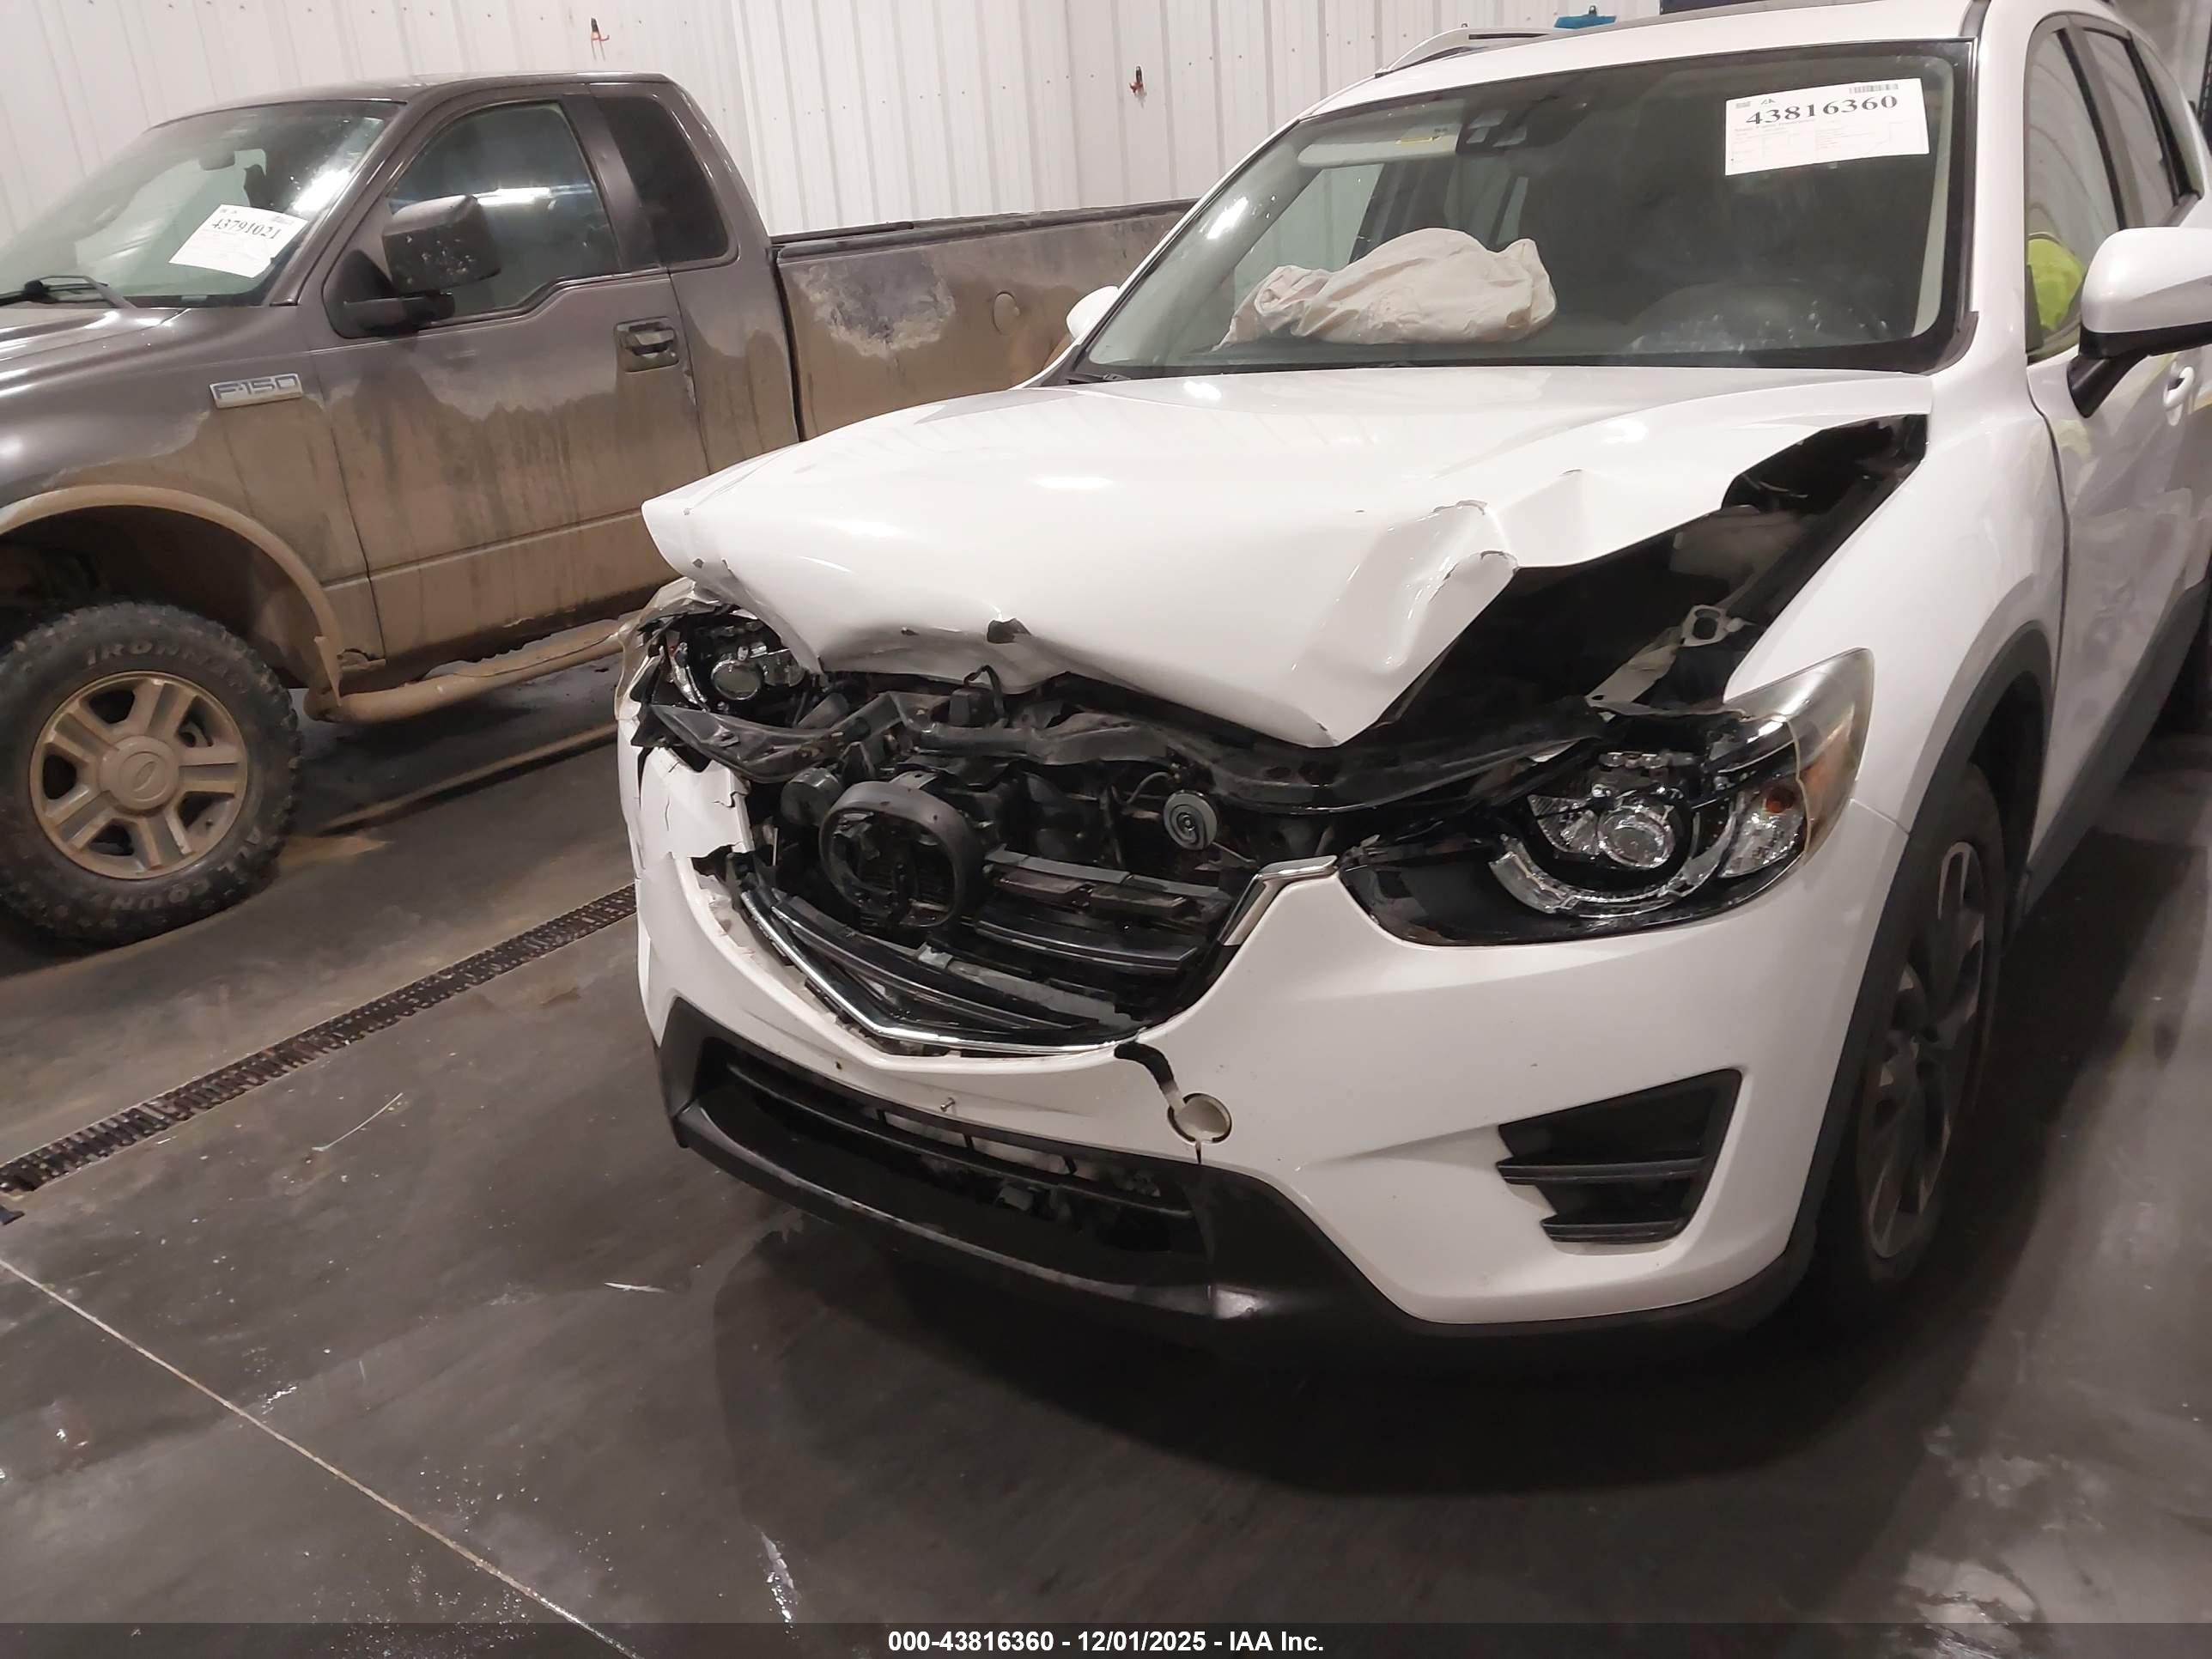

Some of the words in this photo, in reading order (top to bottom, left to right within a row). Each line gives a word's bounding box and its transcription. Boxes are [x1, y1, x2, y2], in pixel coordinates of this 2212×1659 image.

[1745, 94, 1898, 125] 43816360
[212, 217, 283, 240] 43791021
[212, 375, 299, 399] F-150
